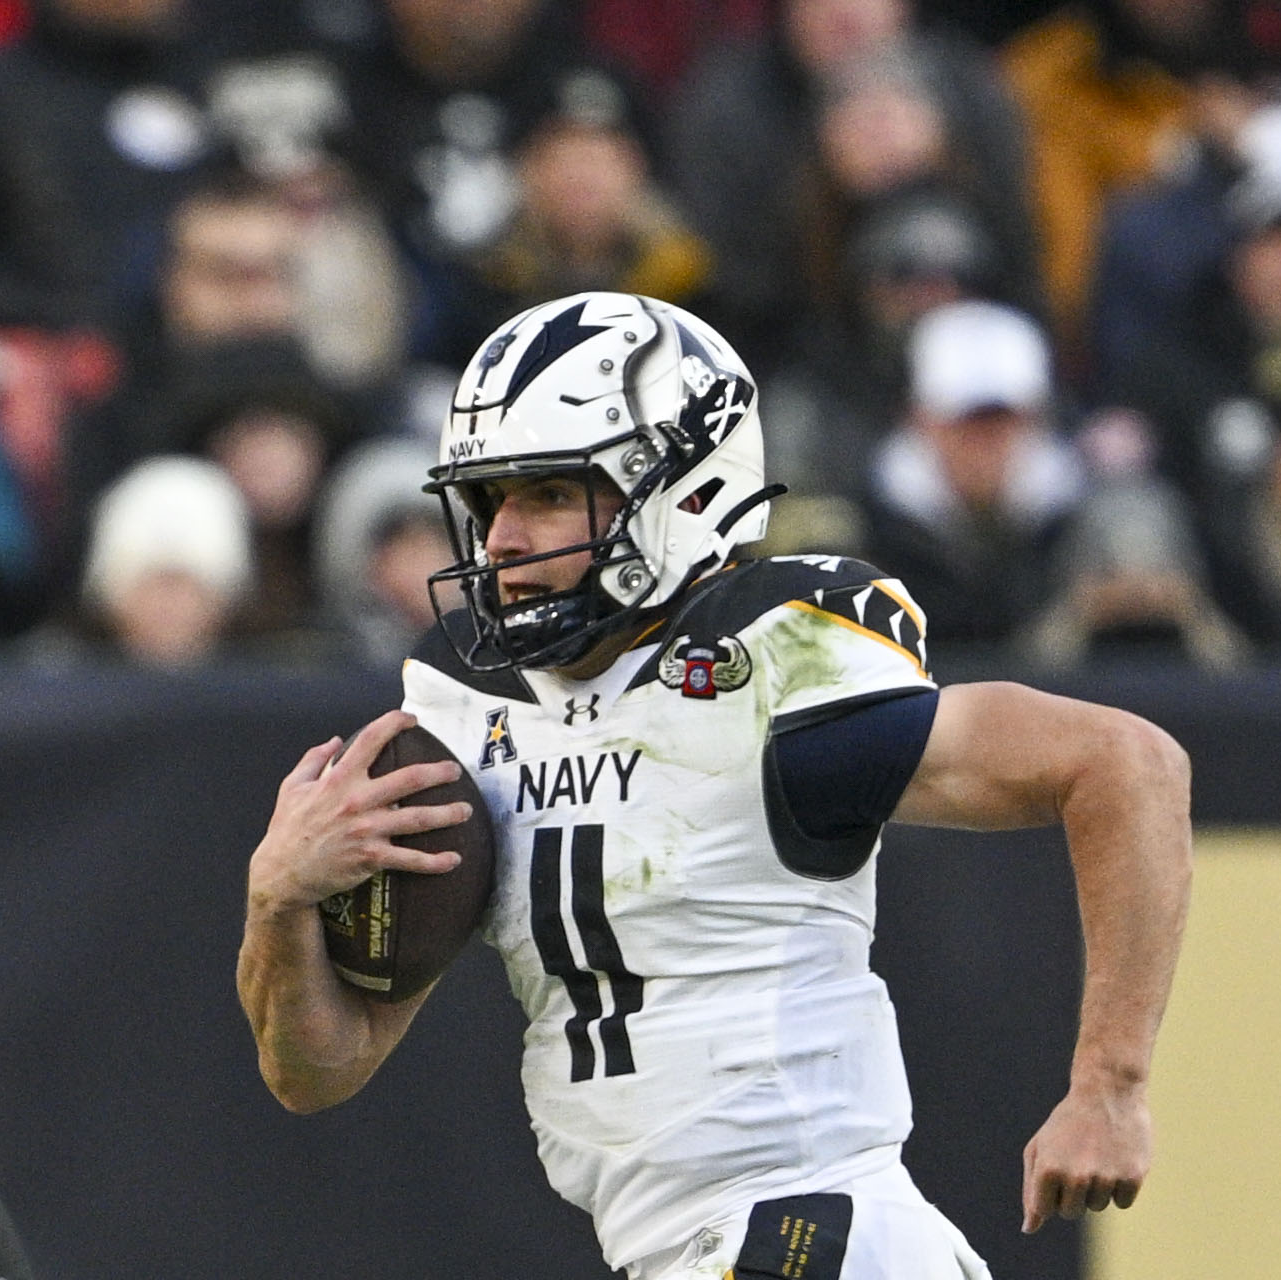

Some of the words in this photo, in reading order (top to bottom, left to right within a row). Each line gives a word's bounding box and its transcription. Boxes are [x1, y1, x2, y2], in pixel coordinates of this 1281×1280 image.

[448, 438, 487, 462] NAVY
[515, 749, 643, 814] NAVY
[529, 824, 644, 1083] 11
